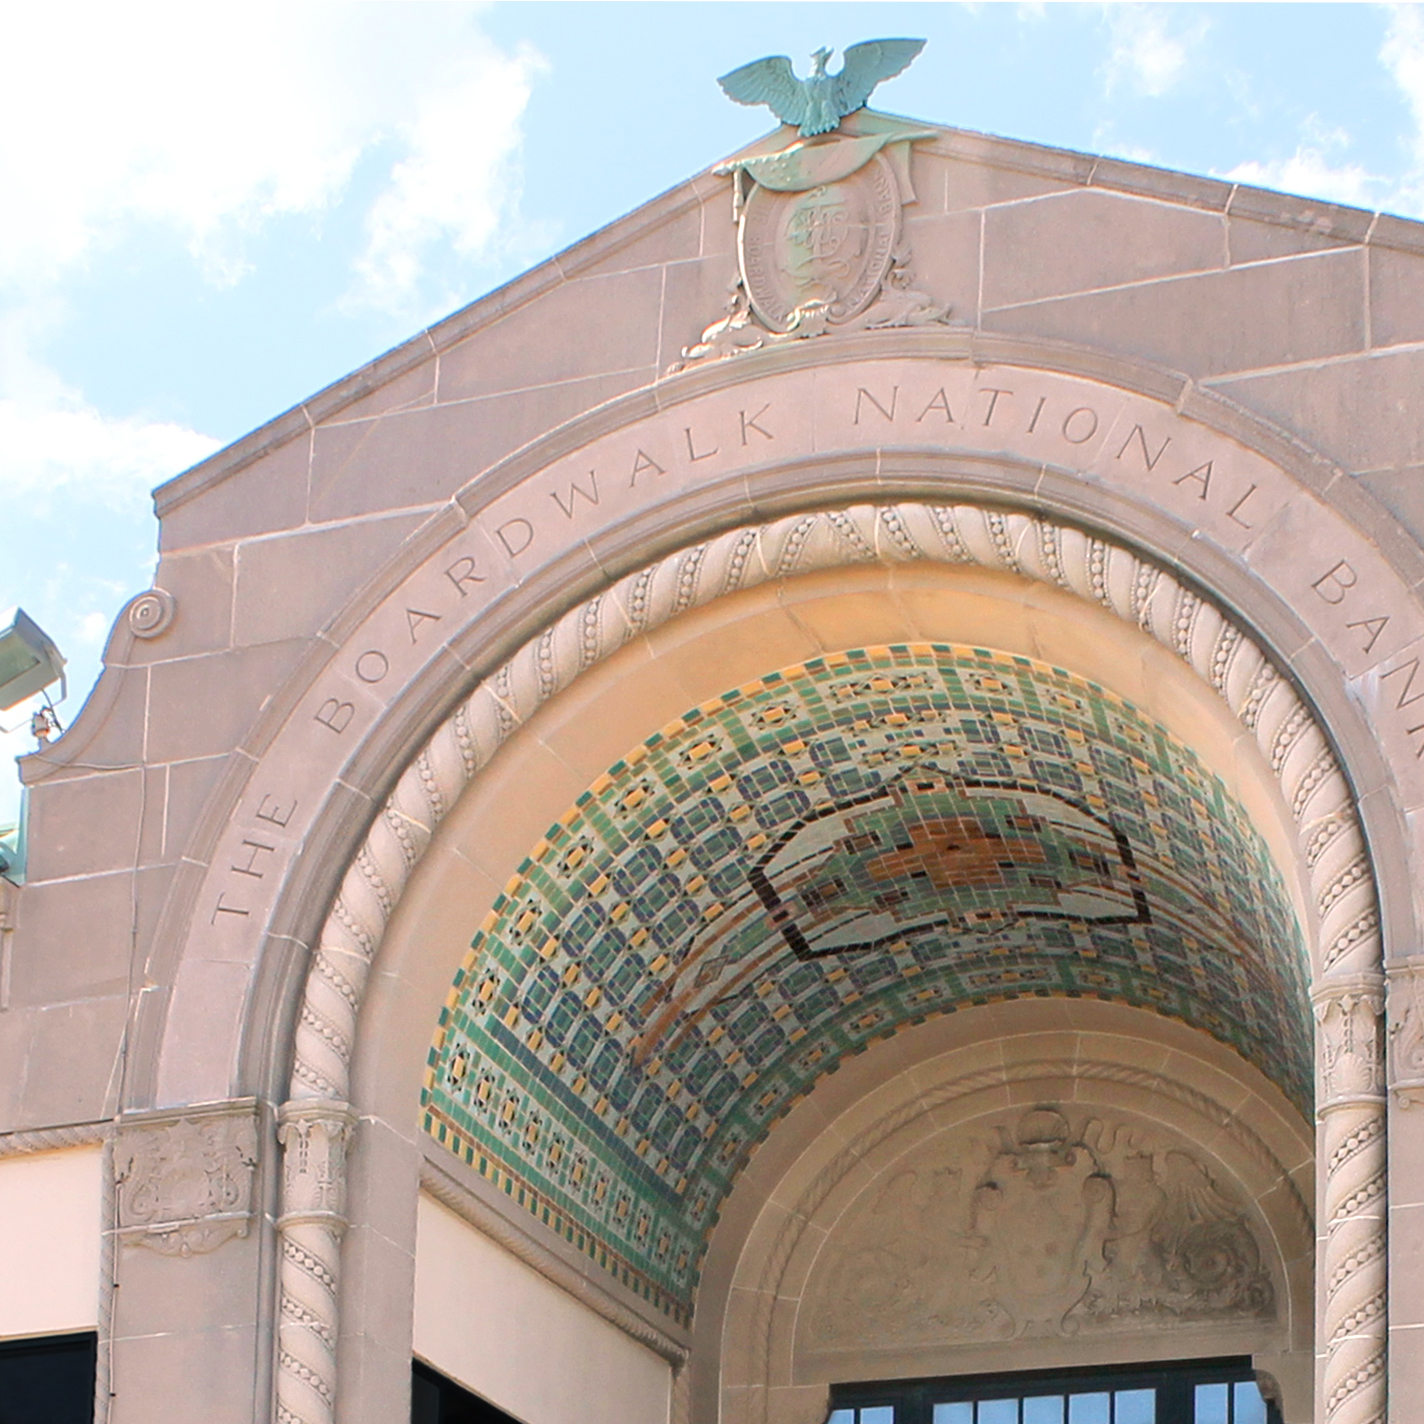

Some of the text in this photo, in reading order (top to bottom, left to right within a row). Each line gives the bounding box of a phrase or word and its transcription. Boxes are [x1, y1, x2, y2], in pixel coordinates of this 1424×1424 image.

[211, 793, 302, 926] THE
[315, 402, 775, 738] BOARDWALK
[851, 385, 1259, 532] NATIONAL
